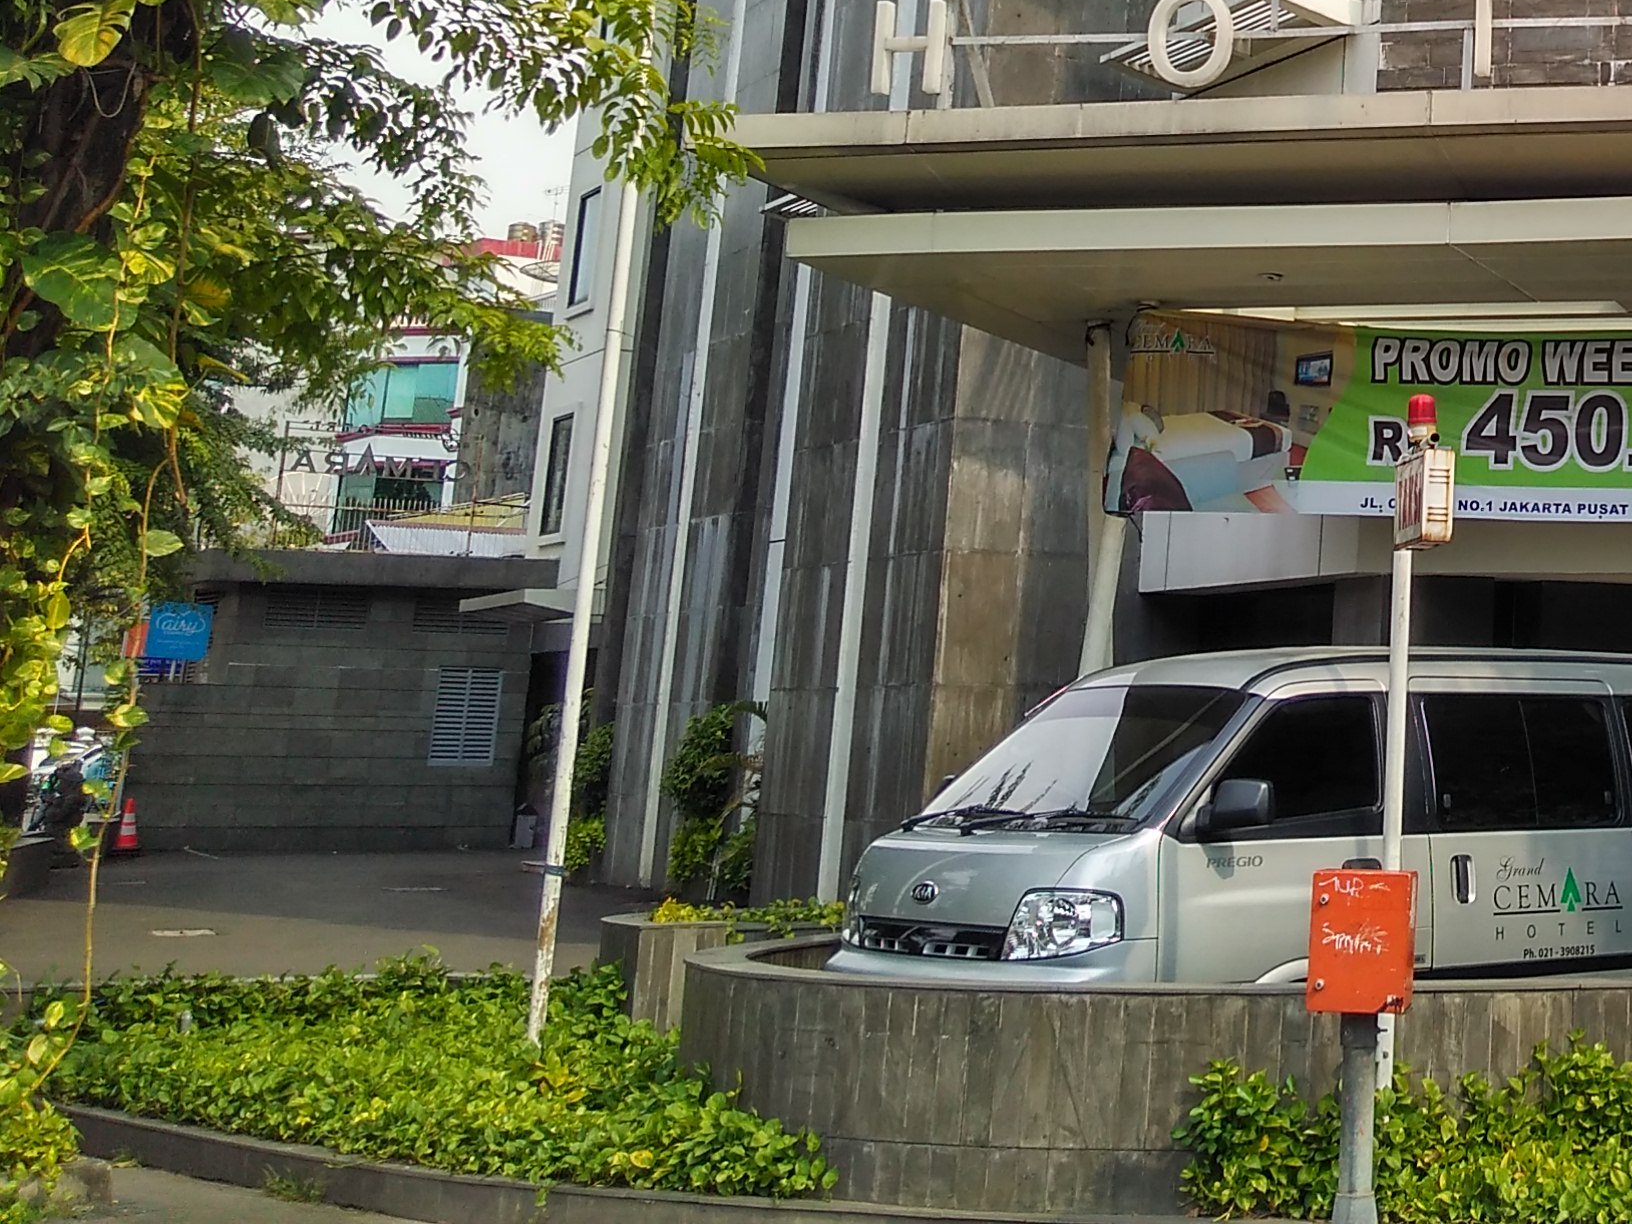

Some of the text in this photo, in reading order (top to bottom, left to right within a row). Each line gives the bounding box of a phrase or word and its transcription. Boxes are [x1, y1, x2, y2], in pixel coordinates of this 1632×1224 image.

[1371, 336, 1532, 386] PROMO
[1498, 500, 1572, 515] JAKARTA
[1577, 502, 1629, 516] PUSAT
[161, 616, 199, 636] airy
[1206, 855, 1264, 869] PREGIO
[1495, 857, 1546, 882] Grand
[1495, 920, 1623, 941] HOTEL
